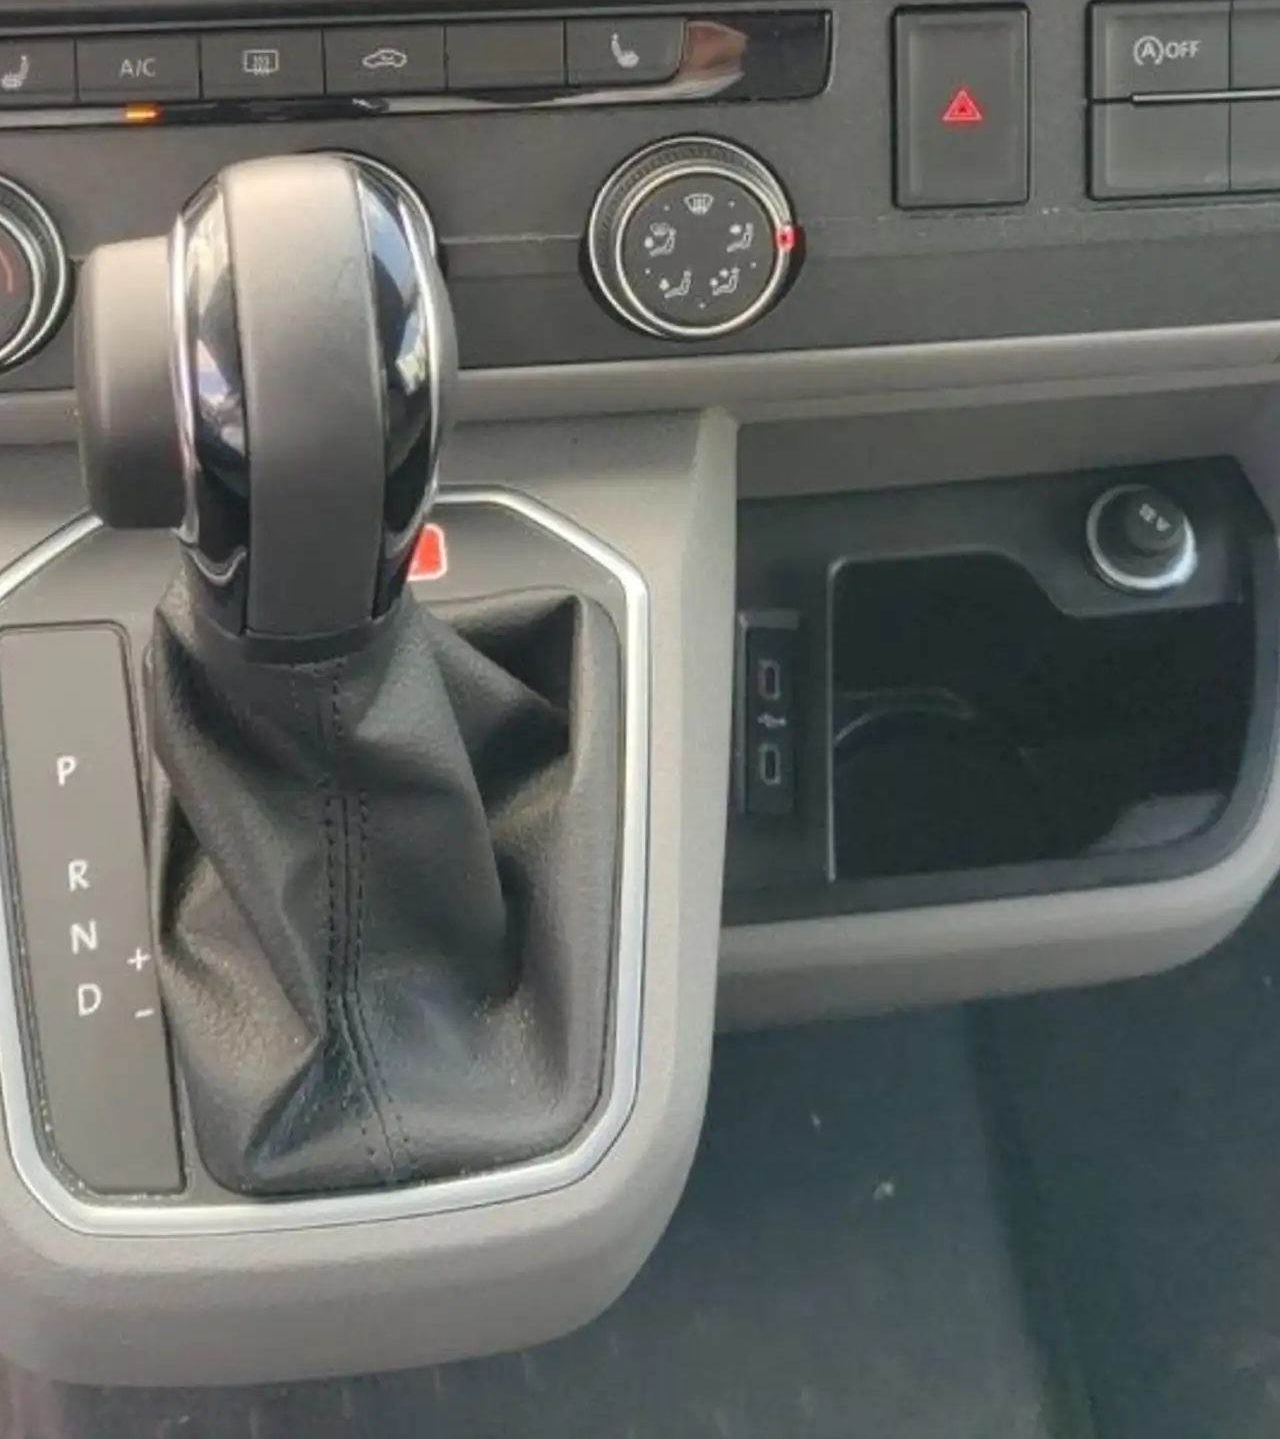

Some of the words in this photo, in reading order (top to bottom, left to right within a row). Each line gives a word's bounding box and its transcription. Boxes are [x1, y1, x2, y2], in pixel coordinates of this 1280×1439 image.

[1165, 40, 1201, 59] OFF
[119, 57, 157, 78] A/C
[57, 755, 77, 786] P
[68, 859, 90, 892] R
[71, 918, 97, 955] N
[77, 983, 102, 1016] D
